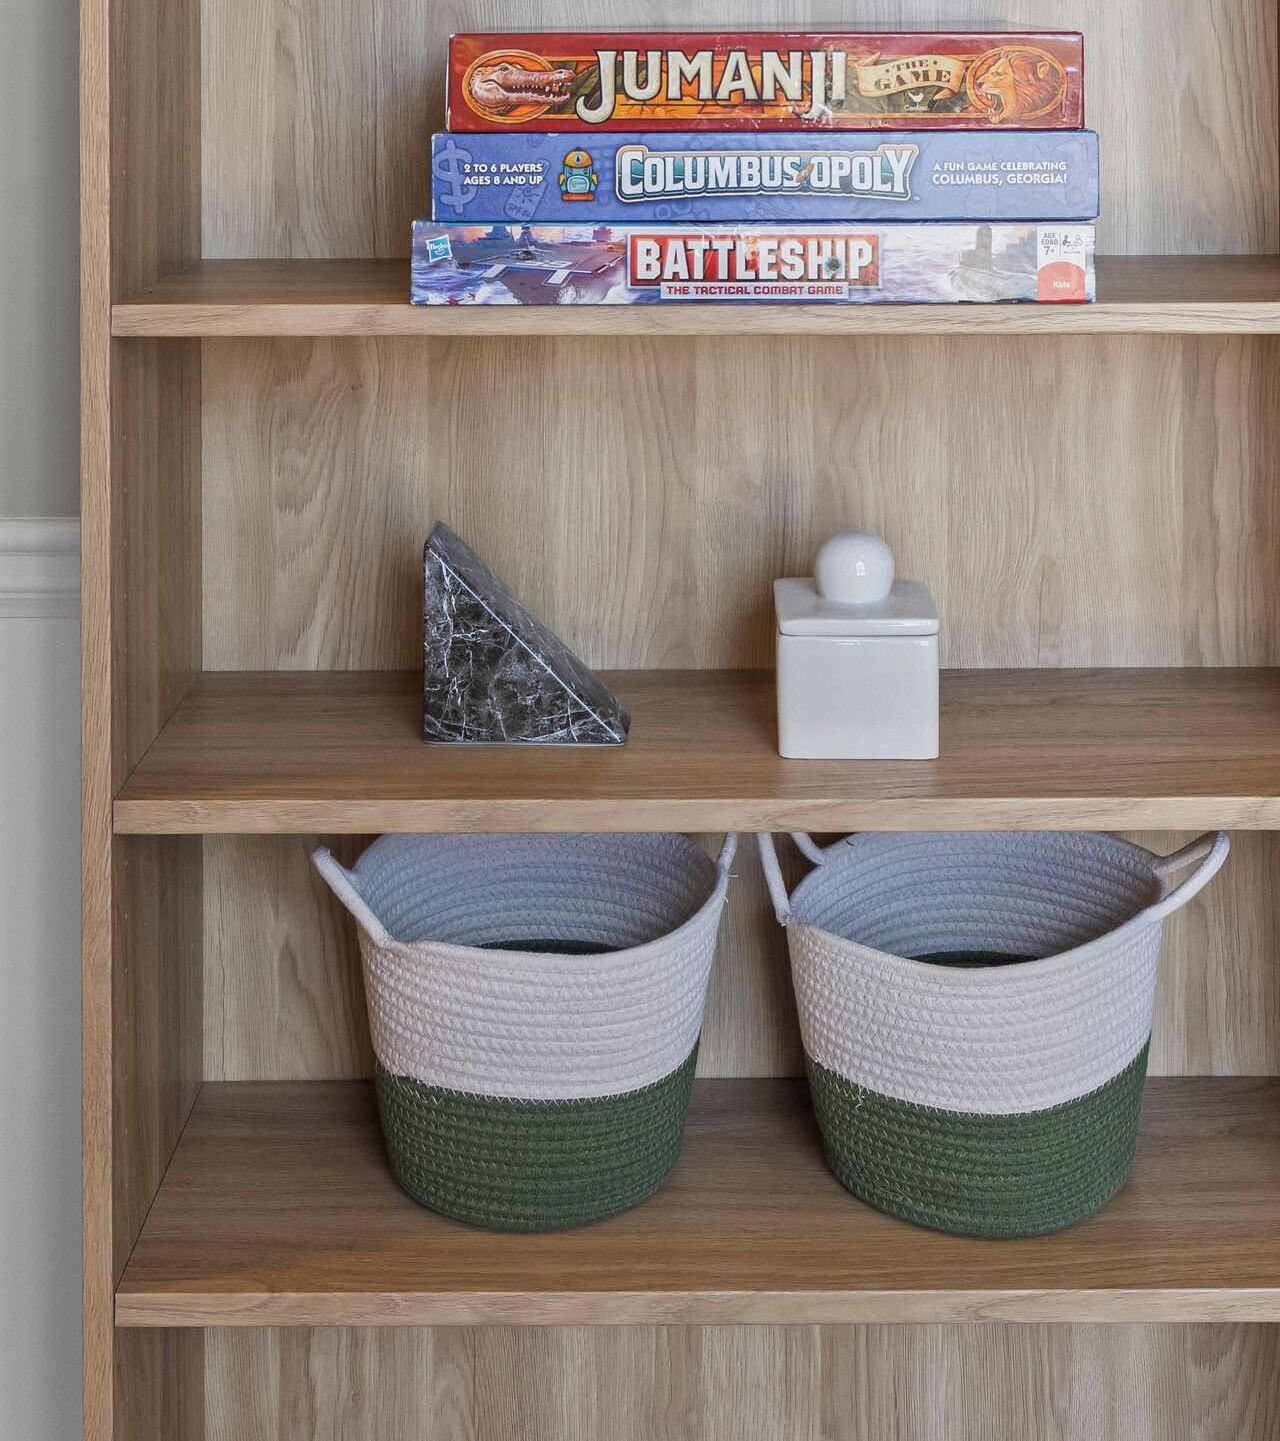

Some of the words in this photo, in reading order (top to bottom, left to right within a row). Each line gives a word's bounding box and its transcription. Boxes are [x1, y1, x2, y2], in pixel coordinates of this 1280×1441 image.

[892, 60, 929, 71] THE
[874, 70, 951, 90] GAME
[575, 50, 847, 124] JUMANJI
[464, 164, 471, 173] 2
[473, 164, 488, 173] TO
[490, 164, 498, 173] 6
[500, 163, 543, 173] PLAYERS
[933, 163, 941, 171] A
[944, 163, 964, 171] FUN
[967, 163, 997, 171] GAME
[1000, 162, 1067, 171] CELEBRATING
[463, 176, 491, 185] AGES
[493, 176, 501, 185] 8
[503, 176, 526, 185] AND
[528, 176, 544, 185] UP
[932, 174, 1003, 186] COLUMBUS,
[1007, 173, 1068, 184] GEORGIA!
[636, 239, 873, 280] BATTLESHIP
[1052, 280, 1071, 288] Kids
[666, 286, 690, 295] THE
[693, 286, 751, 295] TACTICAL
[754, 286, 805, 295] COMBAT
[807, 286, 844, 295] GAME
